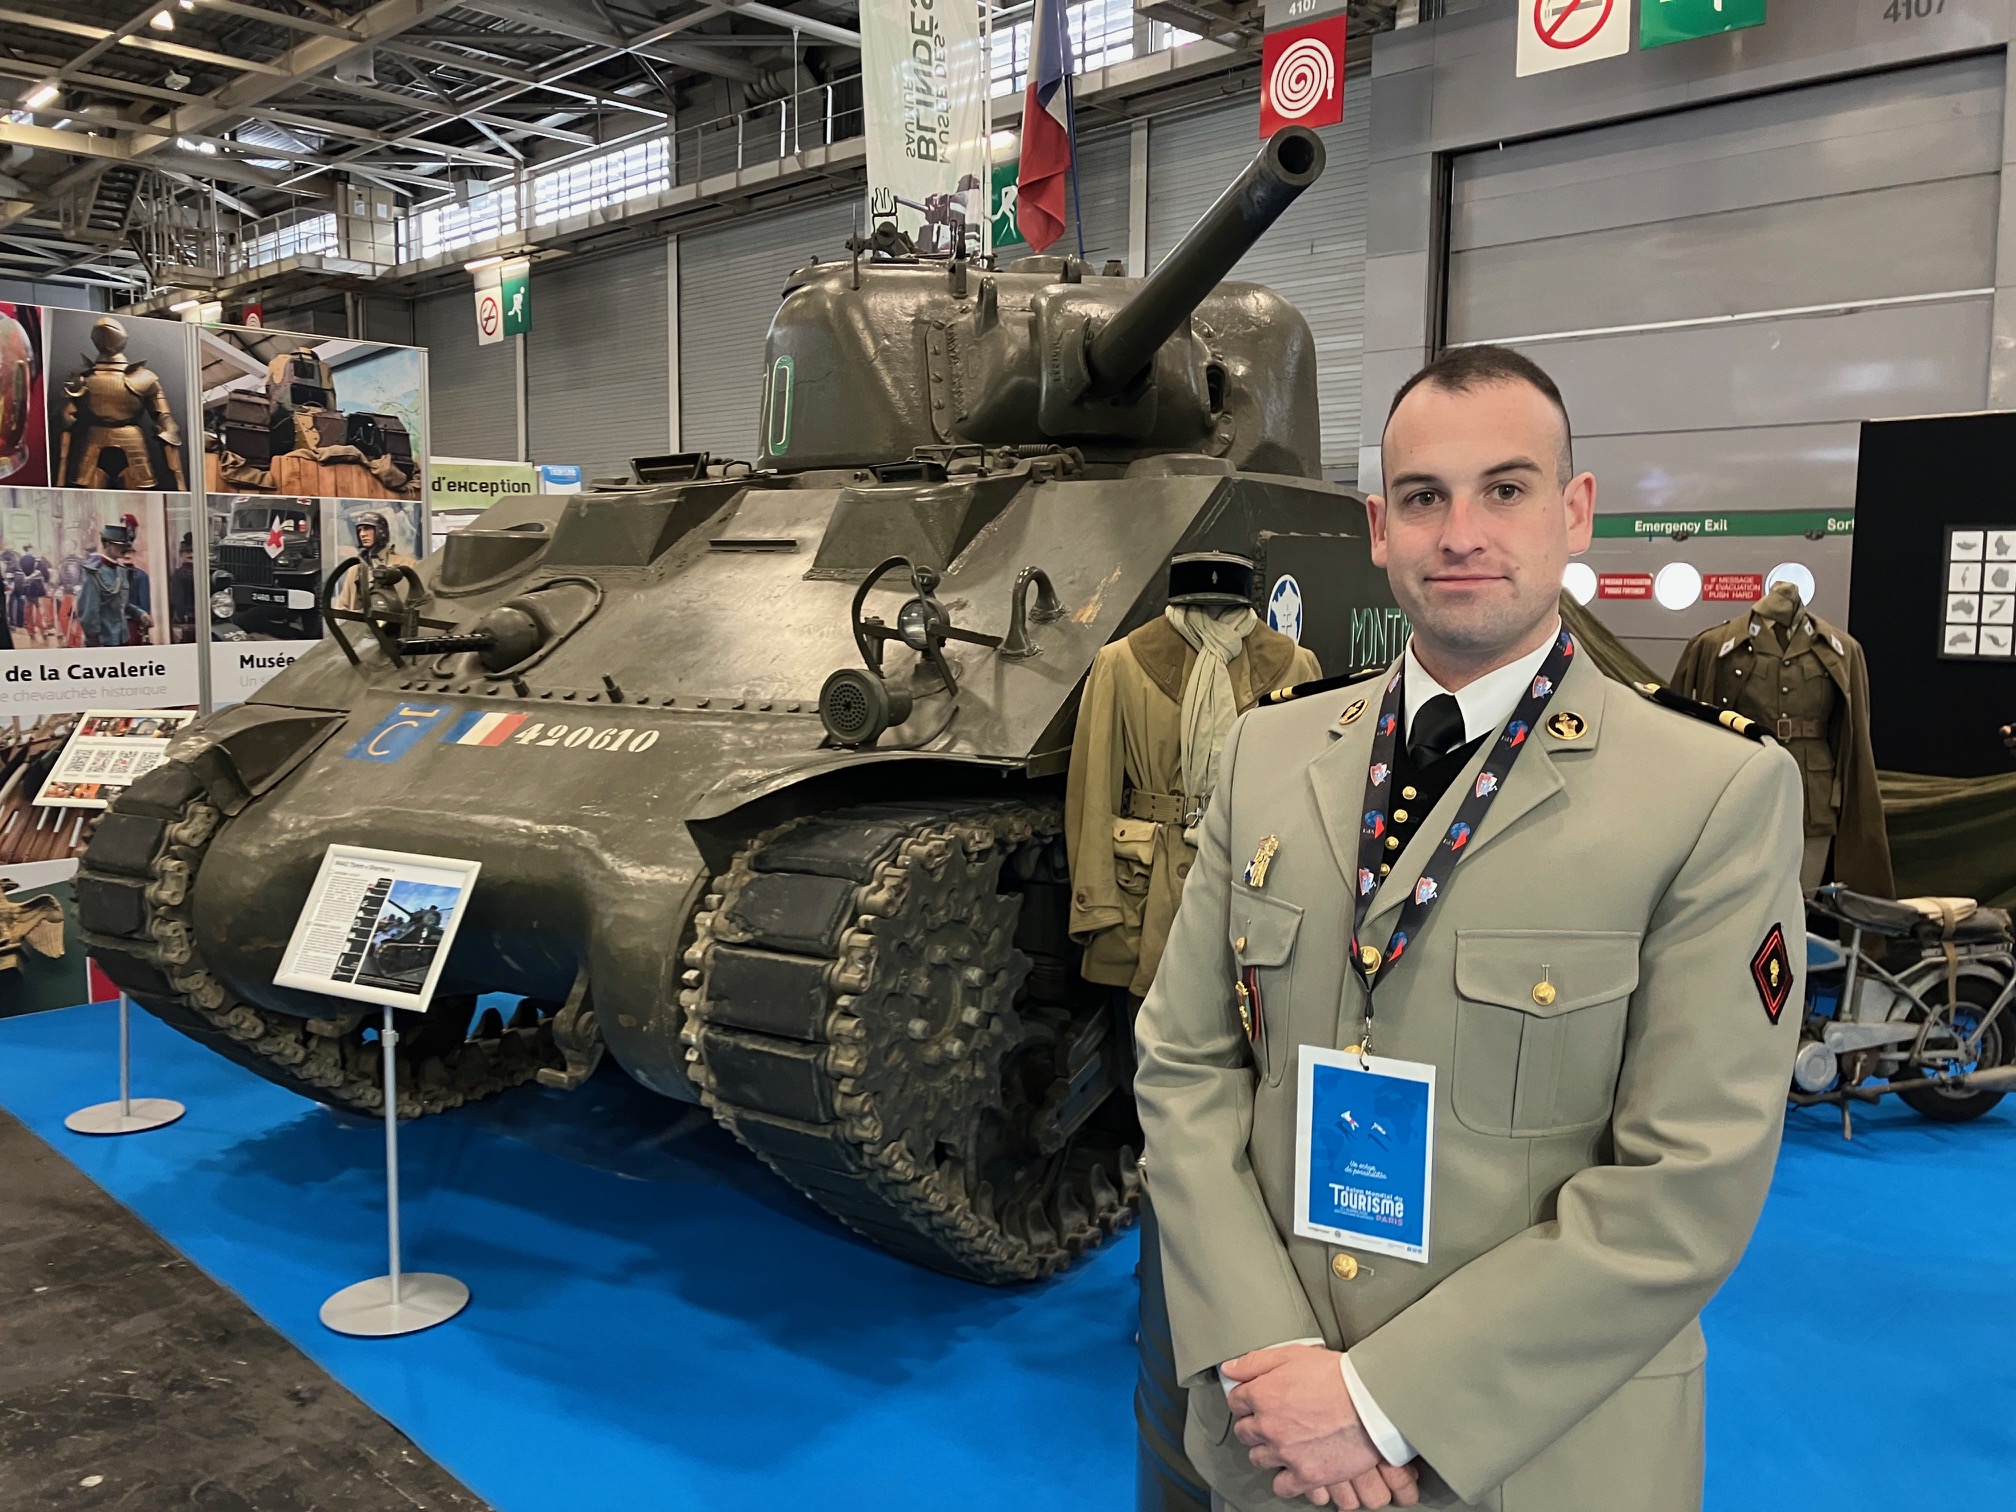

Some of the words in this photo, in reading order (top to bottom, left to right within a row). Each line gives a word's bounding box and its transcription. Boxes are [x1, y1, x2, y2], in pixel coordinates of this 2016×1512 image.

[431, 476, 531, 496] d'exception
[1634, 519, 1701, 533] Emergency
[1704, 517, 1728, 532] Exit
[1709, 591, 1730, 599] PUSH
[1732, 591, 1754, 599] HARD
[240, 652, 295, 668] Musée
[5, 665, 32, 682] de
[40, 665, 60, 681] la
[67, 660, 165, 679] Cavalerie
[13, 687, 97, 702] chevauchée
[101, 685, 167, 698] historique
[514, 723, 660, 753] 420610
[1376, 1214, 1403, 1226] PARIS
